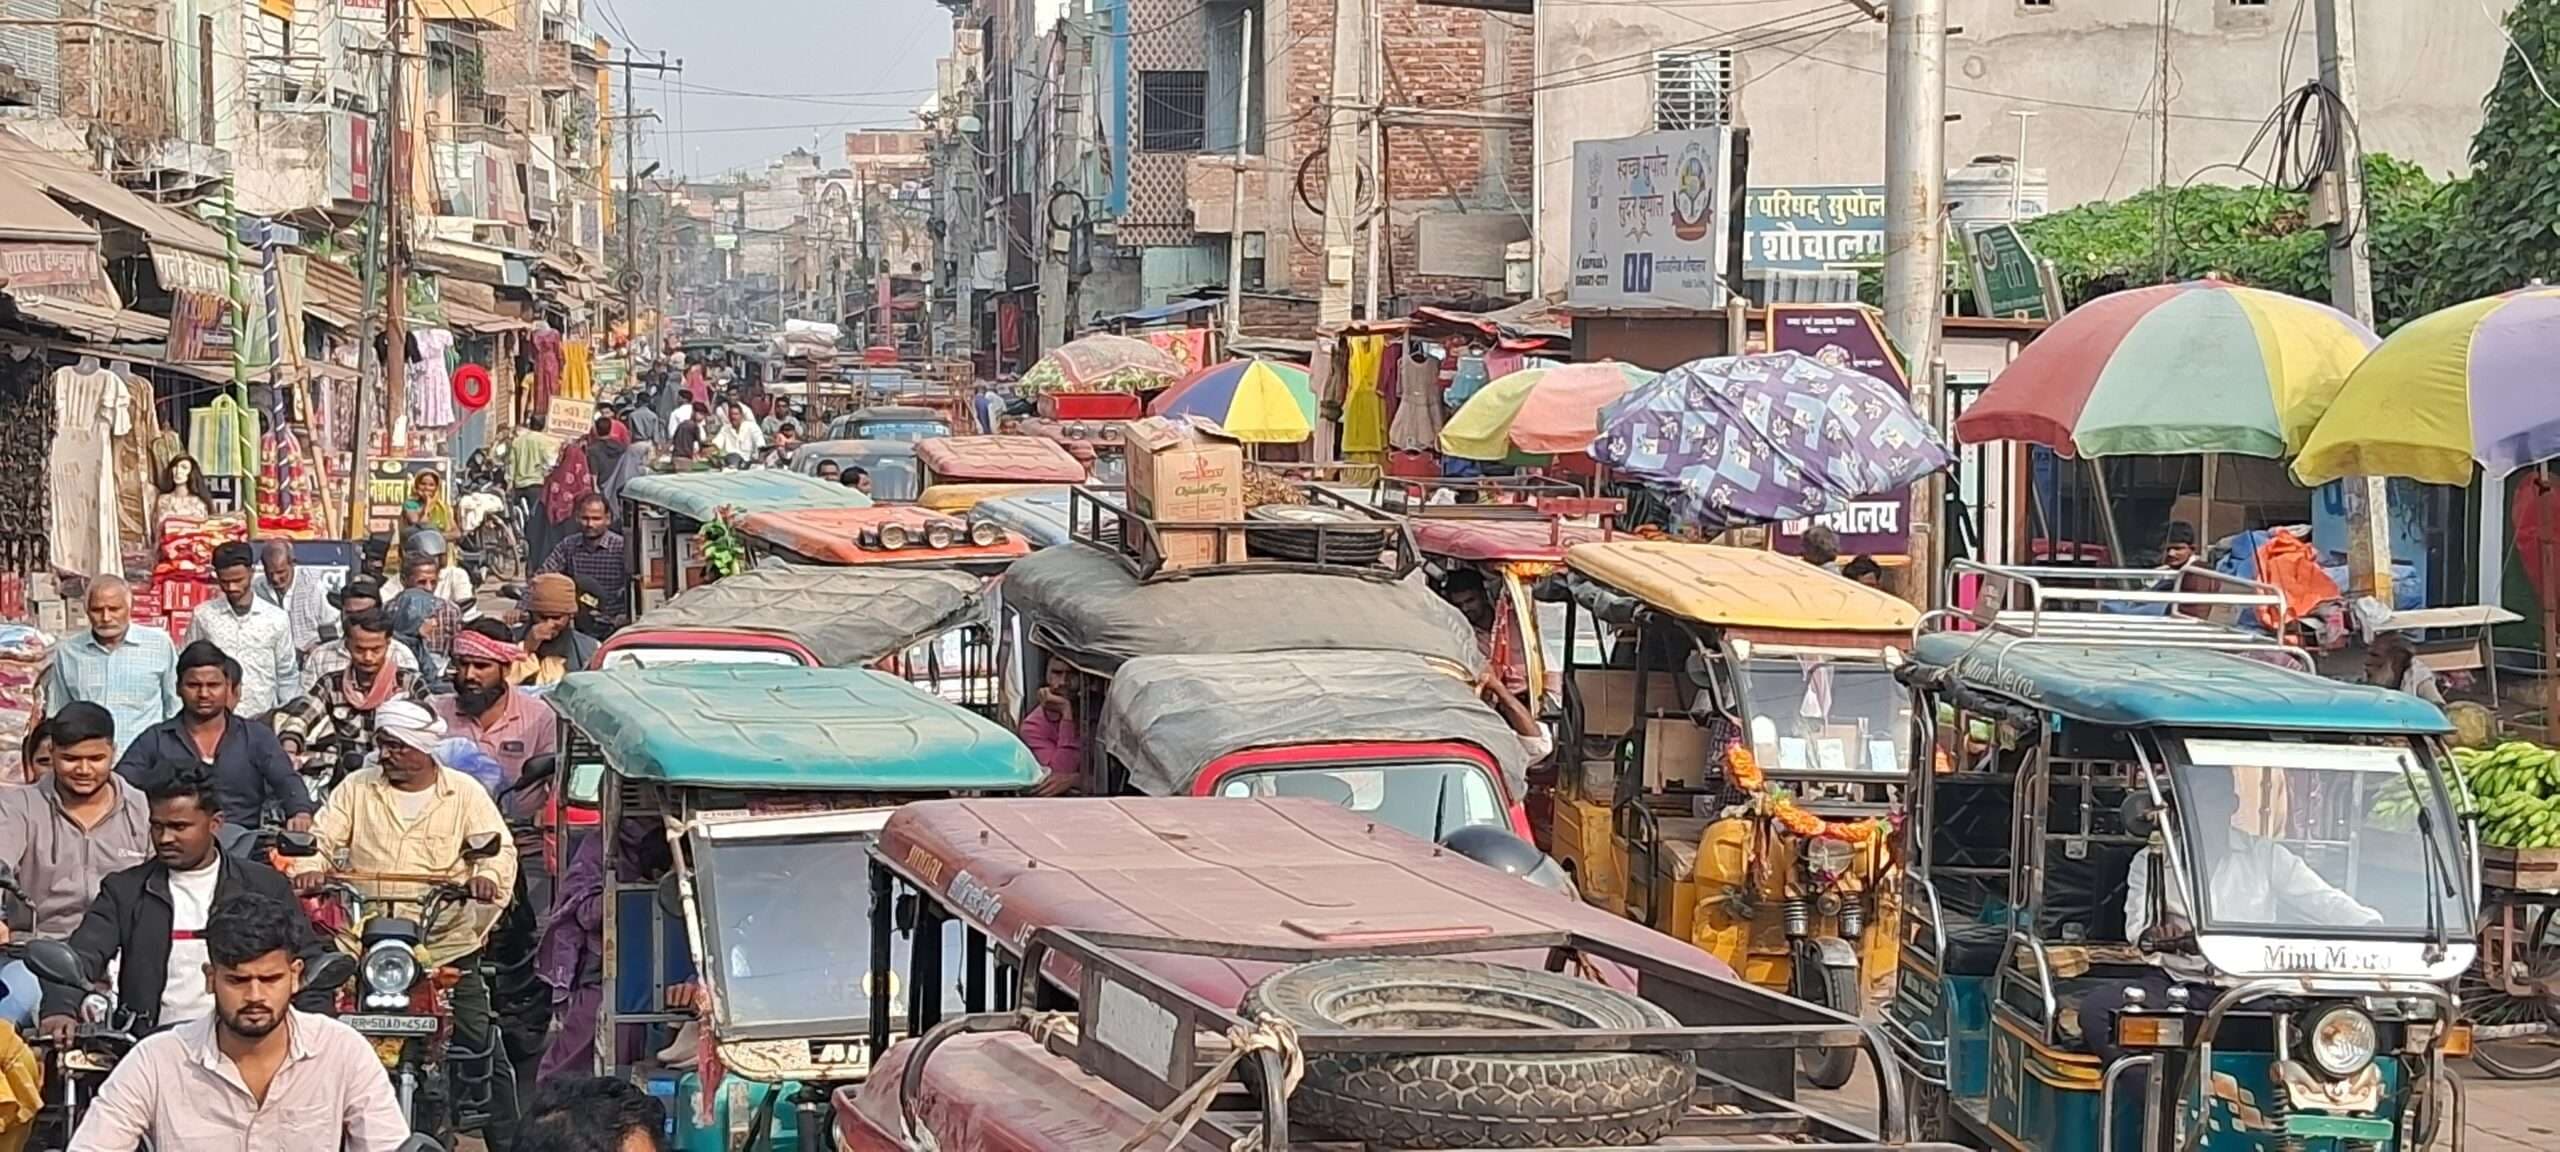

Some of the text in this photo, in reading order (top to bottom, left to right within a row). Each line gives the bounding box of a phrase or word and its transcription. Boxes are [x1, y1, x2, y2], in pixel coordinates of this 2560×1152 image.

[1757, 188, 1824, 224] परिषद्
[1826, 188, 1885, 226] सुपौल
[905, 844, 943, 886] JINDAL
[2264, 945, 2318, 971] Mini
